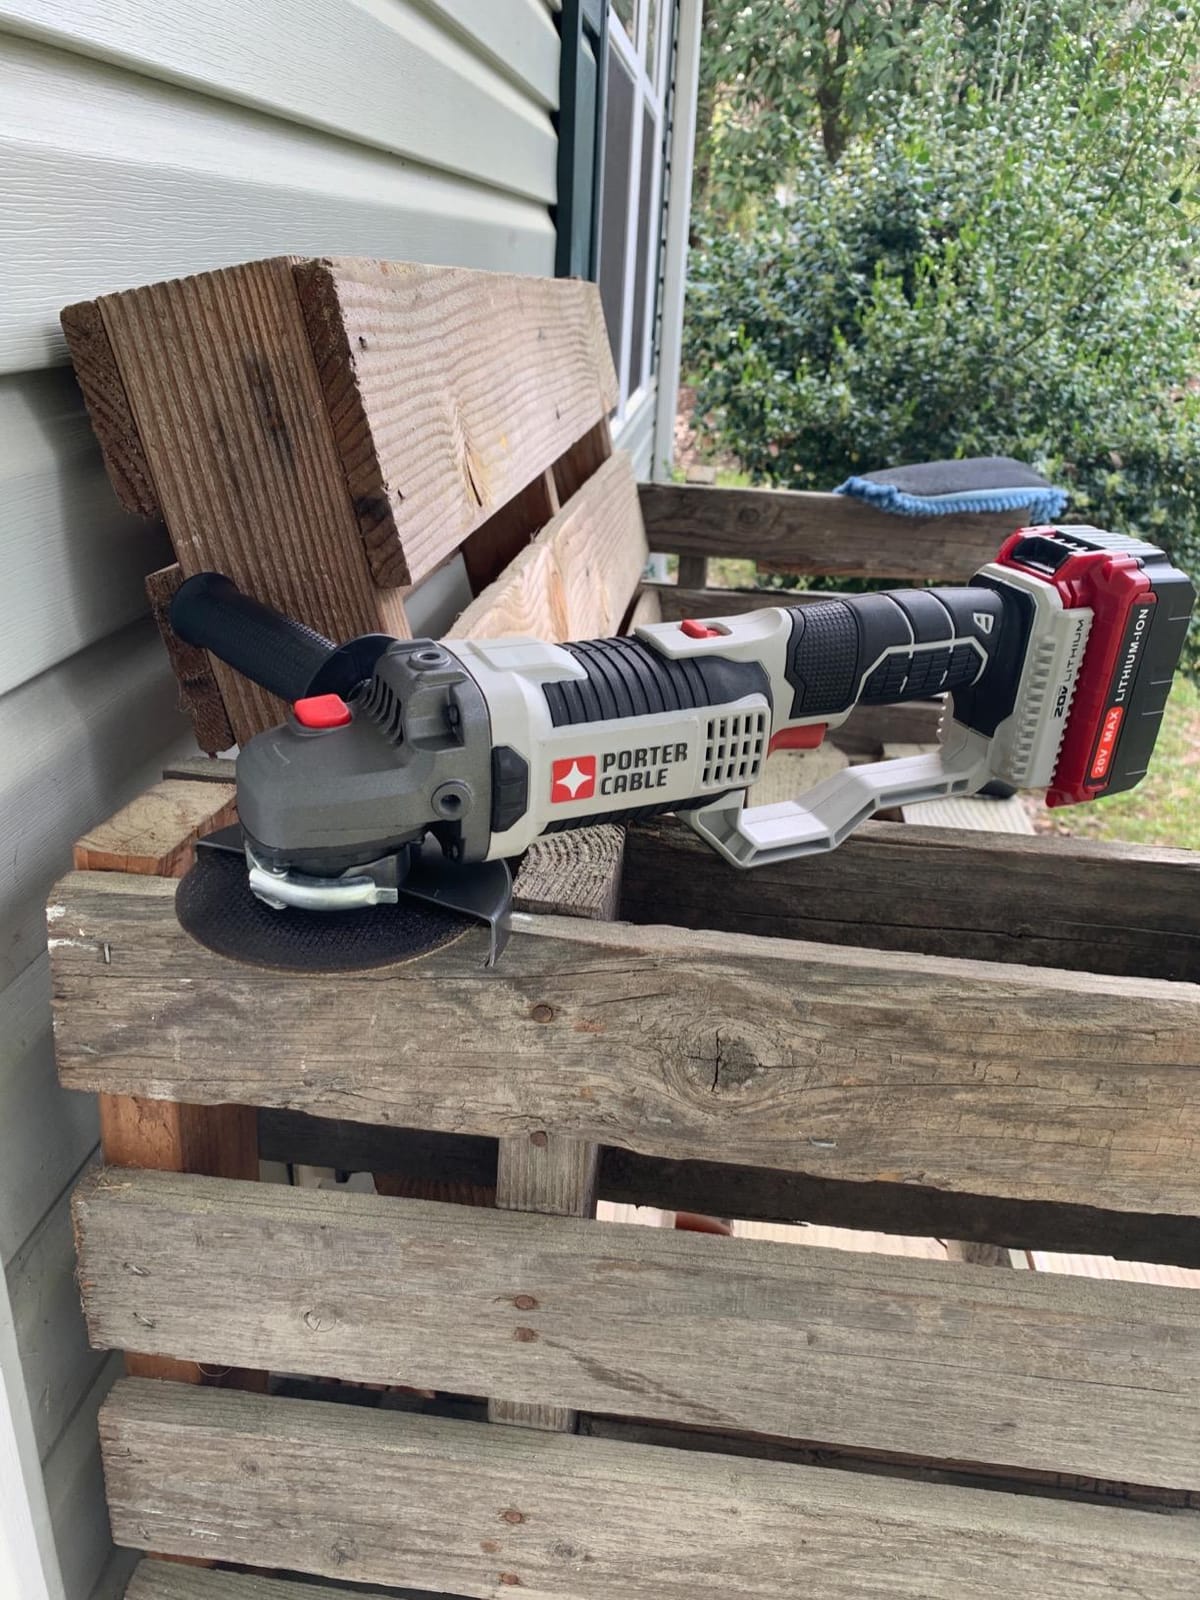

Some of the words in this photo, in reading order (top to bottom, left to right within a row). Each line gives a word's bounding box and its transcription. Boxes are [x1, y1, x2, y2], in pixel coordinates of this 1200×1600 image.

[1065, 618, 1084, 682] LITHIUM
[1095, 748, 1108, 774] 20V
[1103, 711, 1119, 743] MAX
[1115, 608, 1149, 702] LITHIUM-ION
[602, 742, 688, 773] PORTER
[600, 768, 668, 795] CABLE
